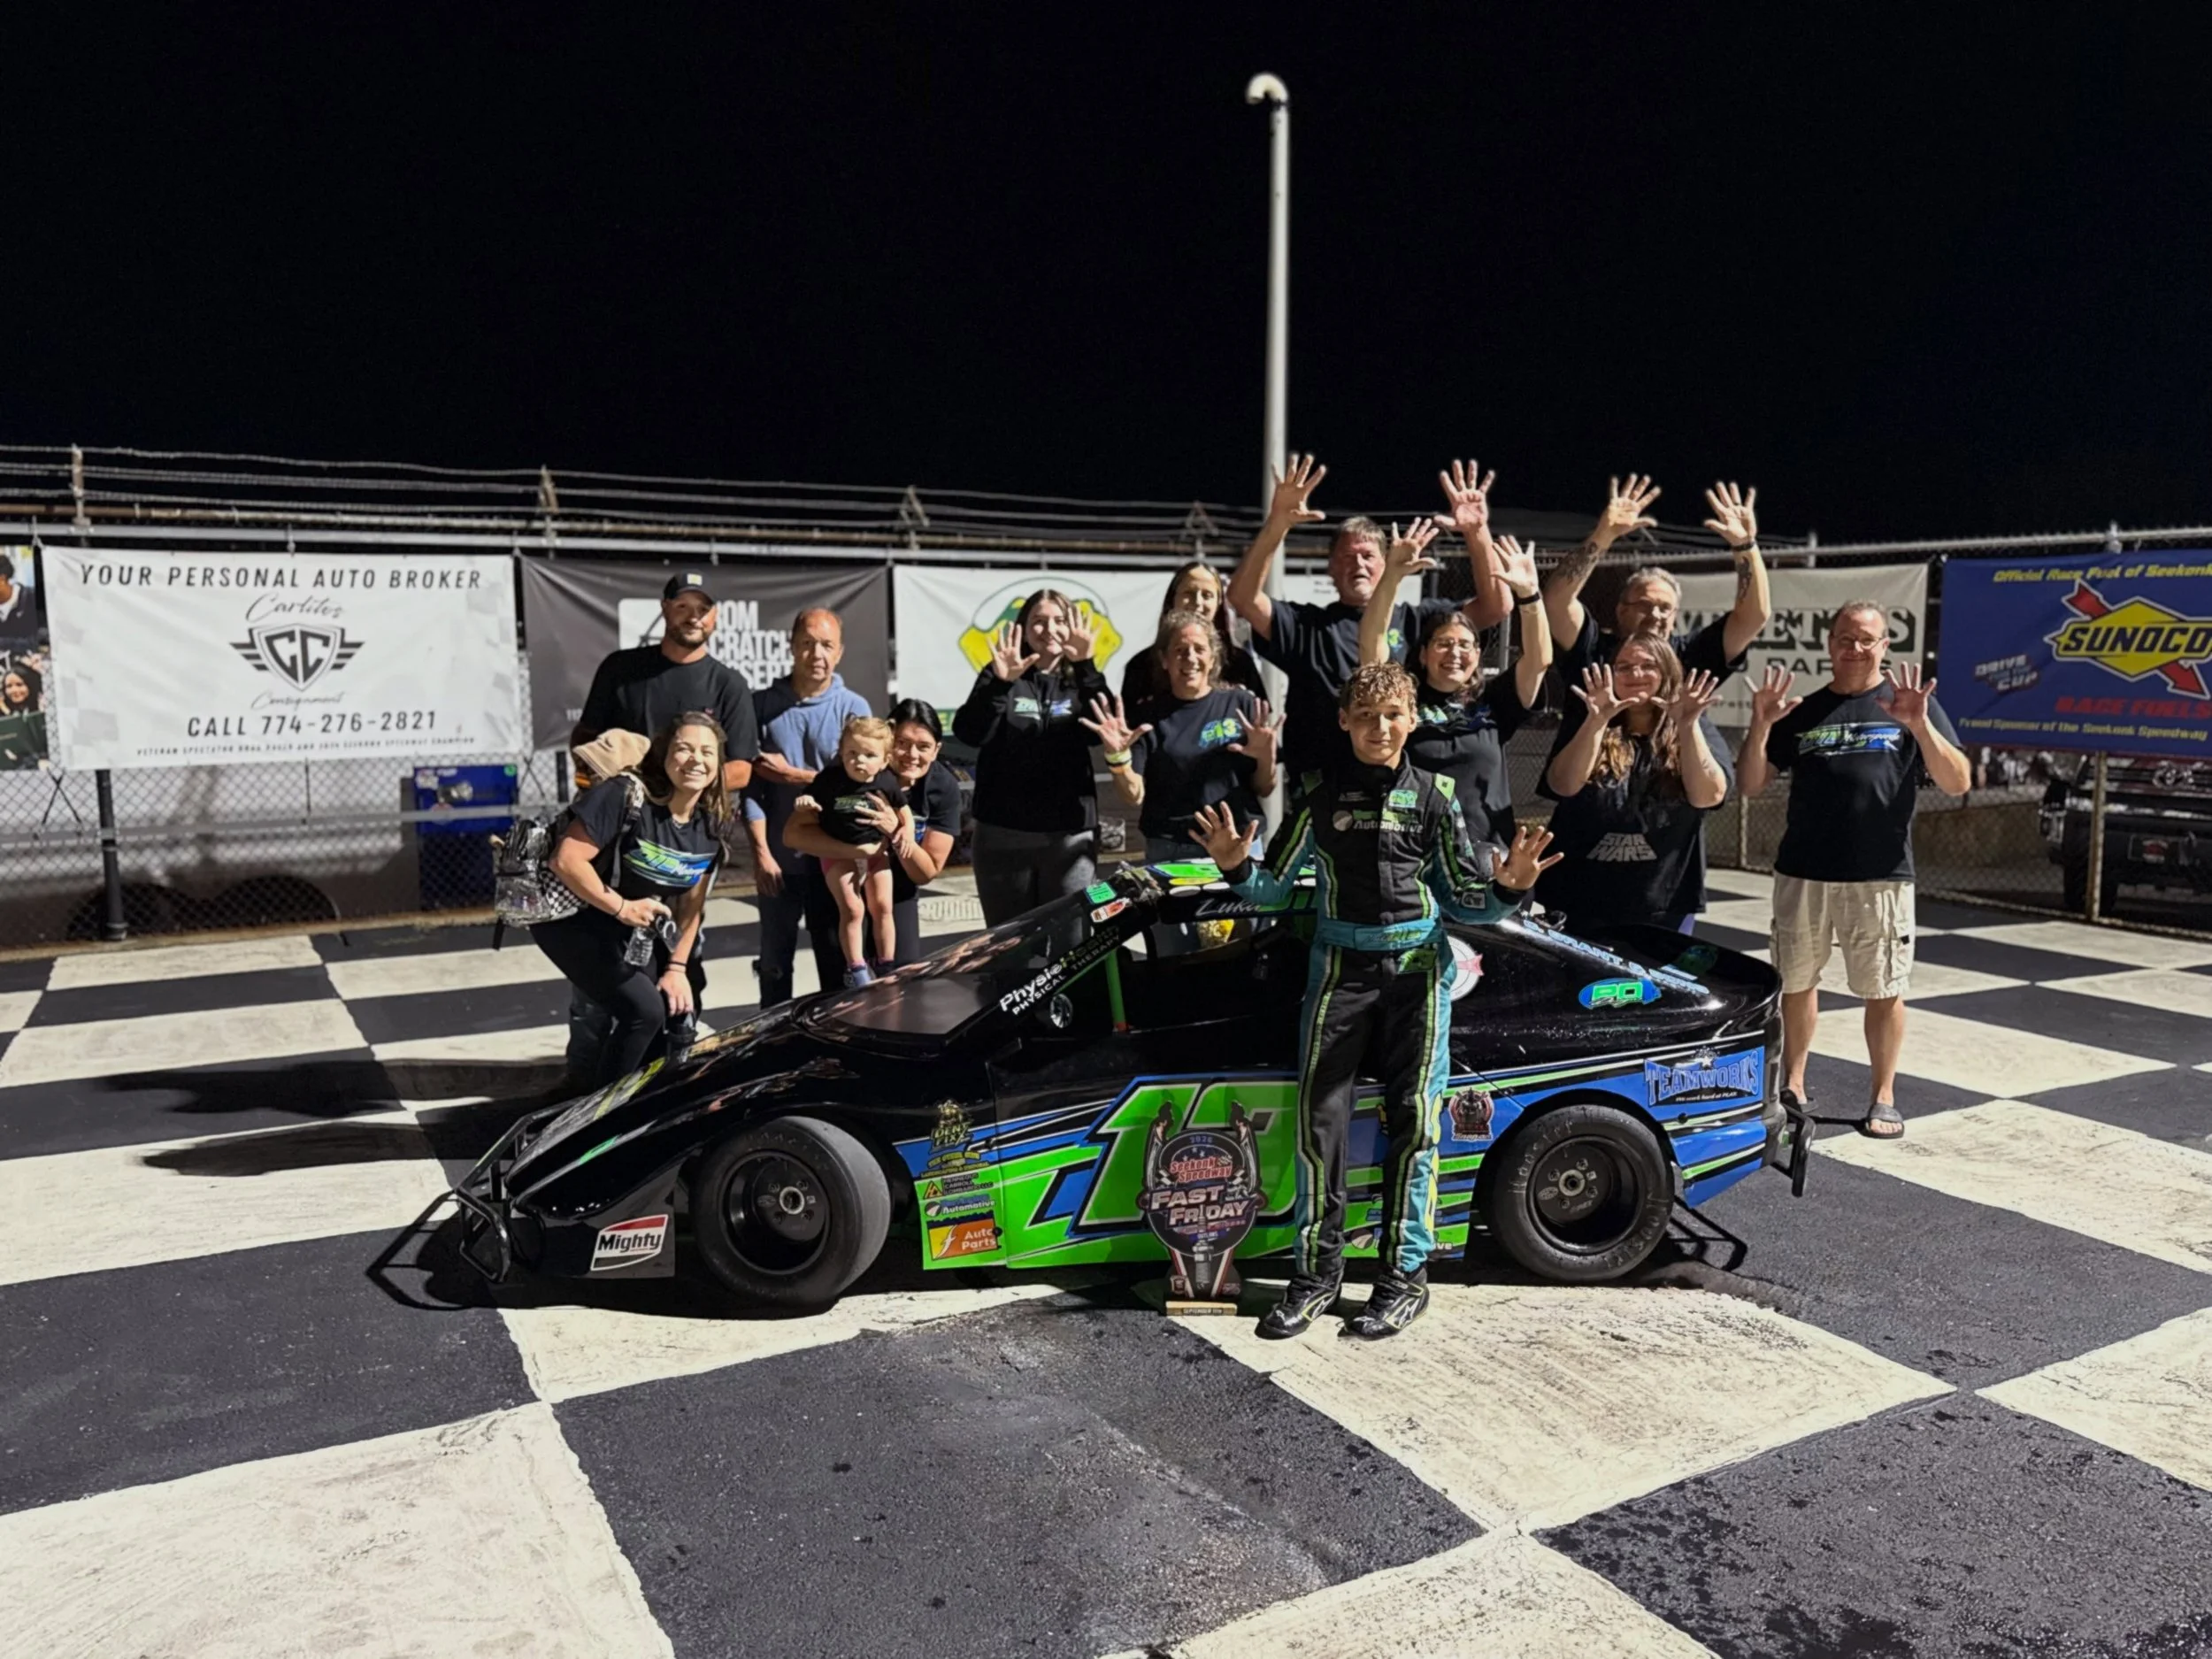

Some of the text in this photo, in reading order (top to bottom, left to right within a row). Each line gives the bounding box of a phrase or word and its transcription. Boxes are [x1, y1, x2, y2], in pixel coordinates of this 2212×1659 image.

[81, 564, 480, 588] YOUR PERSONAL AUTO BROKER
[2086, 566, 2122, 579] Fuel
[2124, 565, 2145, 578] of
[708, 629, 794, 662] CRATCH
[2062, 626, 2212, 653] SUNOCO
[265, 629, 331, 684] CC
[1996, 671, 2038, 691] CUP
[2055, 697, 2212, 718] RACE FUELS
[188, 710, 435, 737] CALL 774-276-2821
[2042, 719, 2056, 733] of
[2058, 721, 2079, 733] the
[2139, 725, 2208, 741] Speedway
[1599, 832, 1647, 847] STAR
[1586, 845, 1657, 862] WARS
[1012, 974, 1067, 1015] PHYSICAL
[1645, 1050, 1759, 1106] TEAMWORKS
[1170, 1156, 1217, 1174] Seekonk
[1178, 1164, 1233, 1183] Speedway
[942, 1201, 995, 1214] Automotive
[1150, 1185, 1225, 1210] FAST
[1169, 1200, 1249, 1226] FRIDAY
[598, 1233, 662, 1253] Mighty
[962, 1237, 996, 1250] Parts
[964, 1228, 993, 1240] Auto
